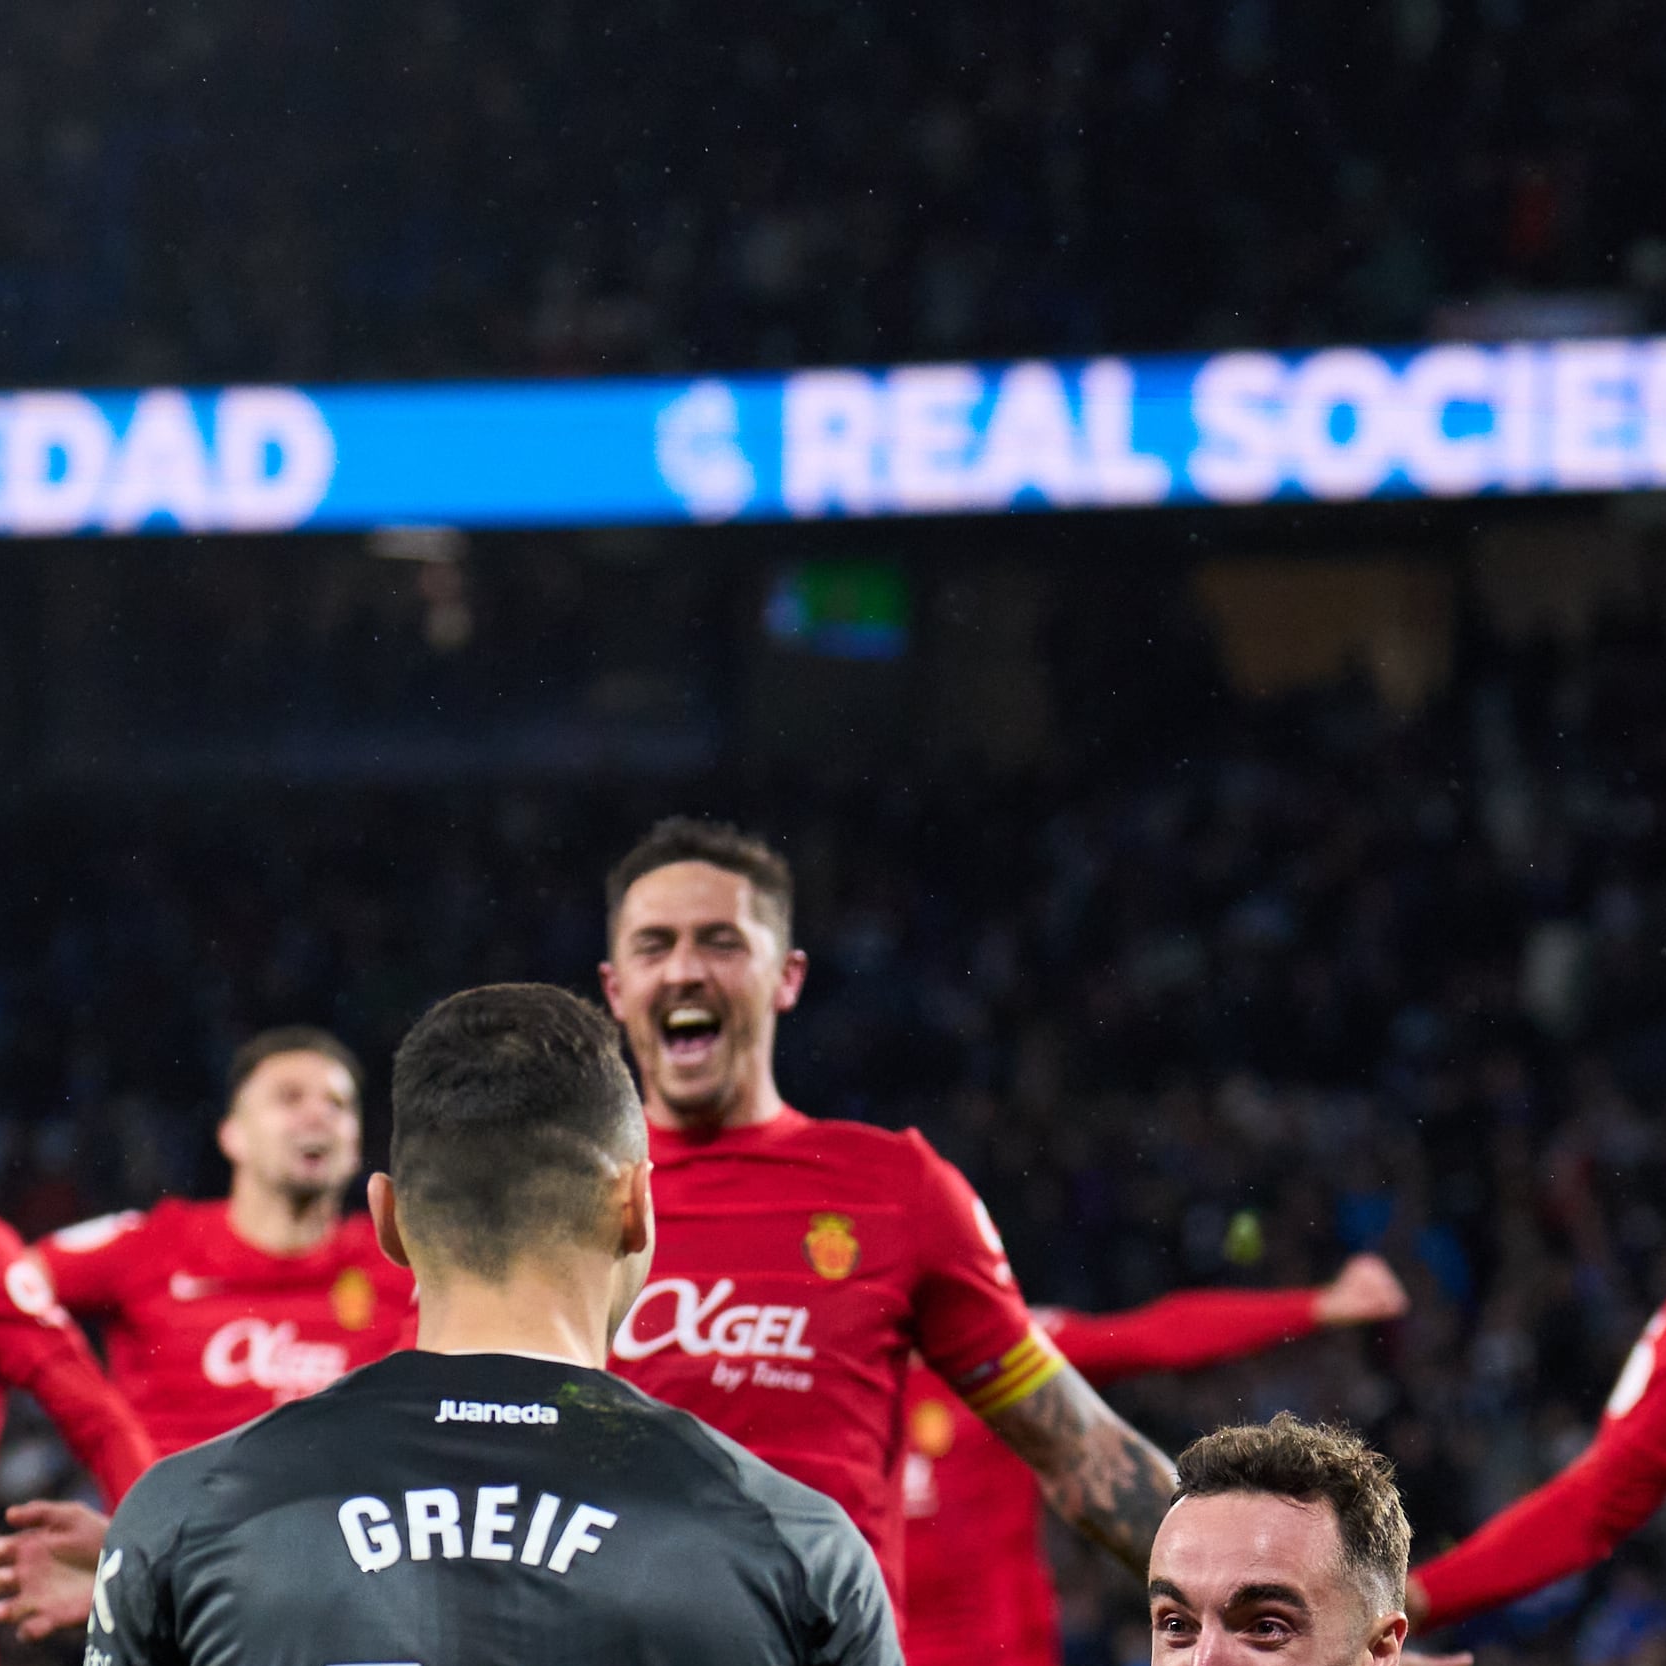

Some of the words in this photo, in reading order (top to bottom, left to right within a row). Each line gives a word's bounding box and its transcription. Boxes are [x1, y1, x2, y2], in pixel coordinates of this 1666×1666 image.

[779, 358, 1173, 520] REAL
[434, 1398, 559, 1424] juaneda
[337, 1483, 619, 1573] GREIF
